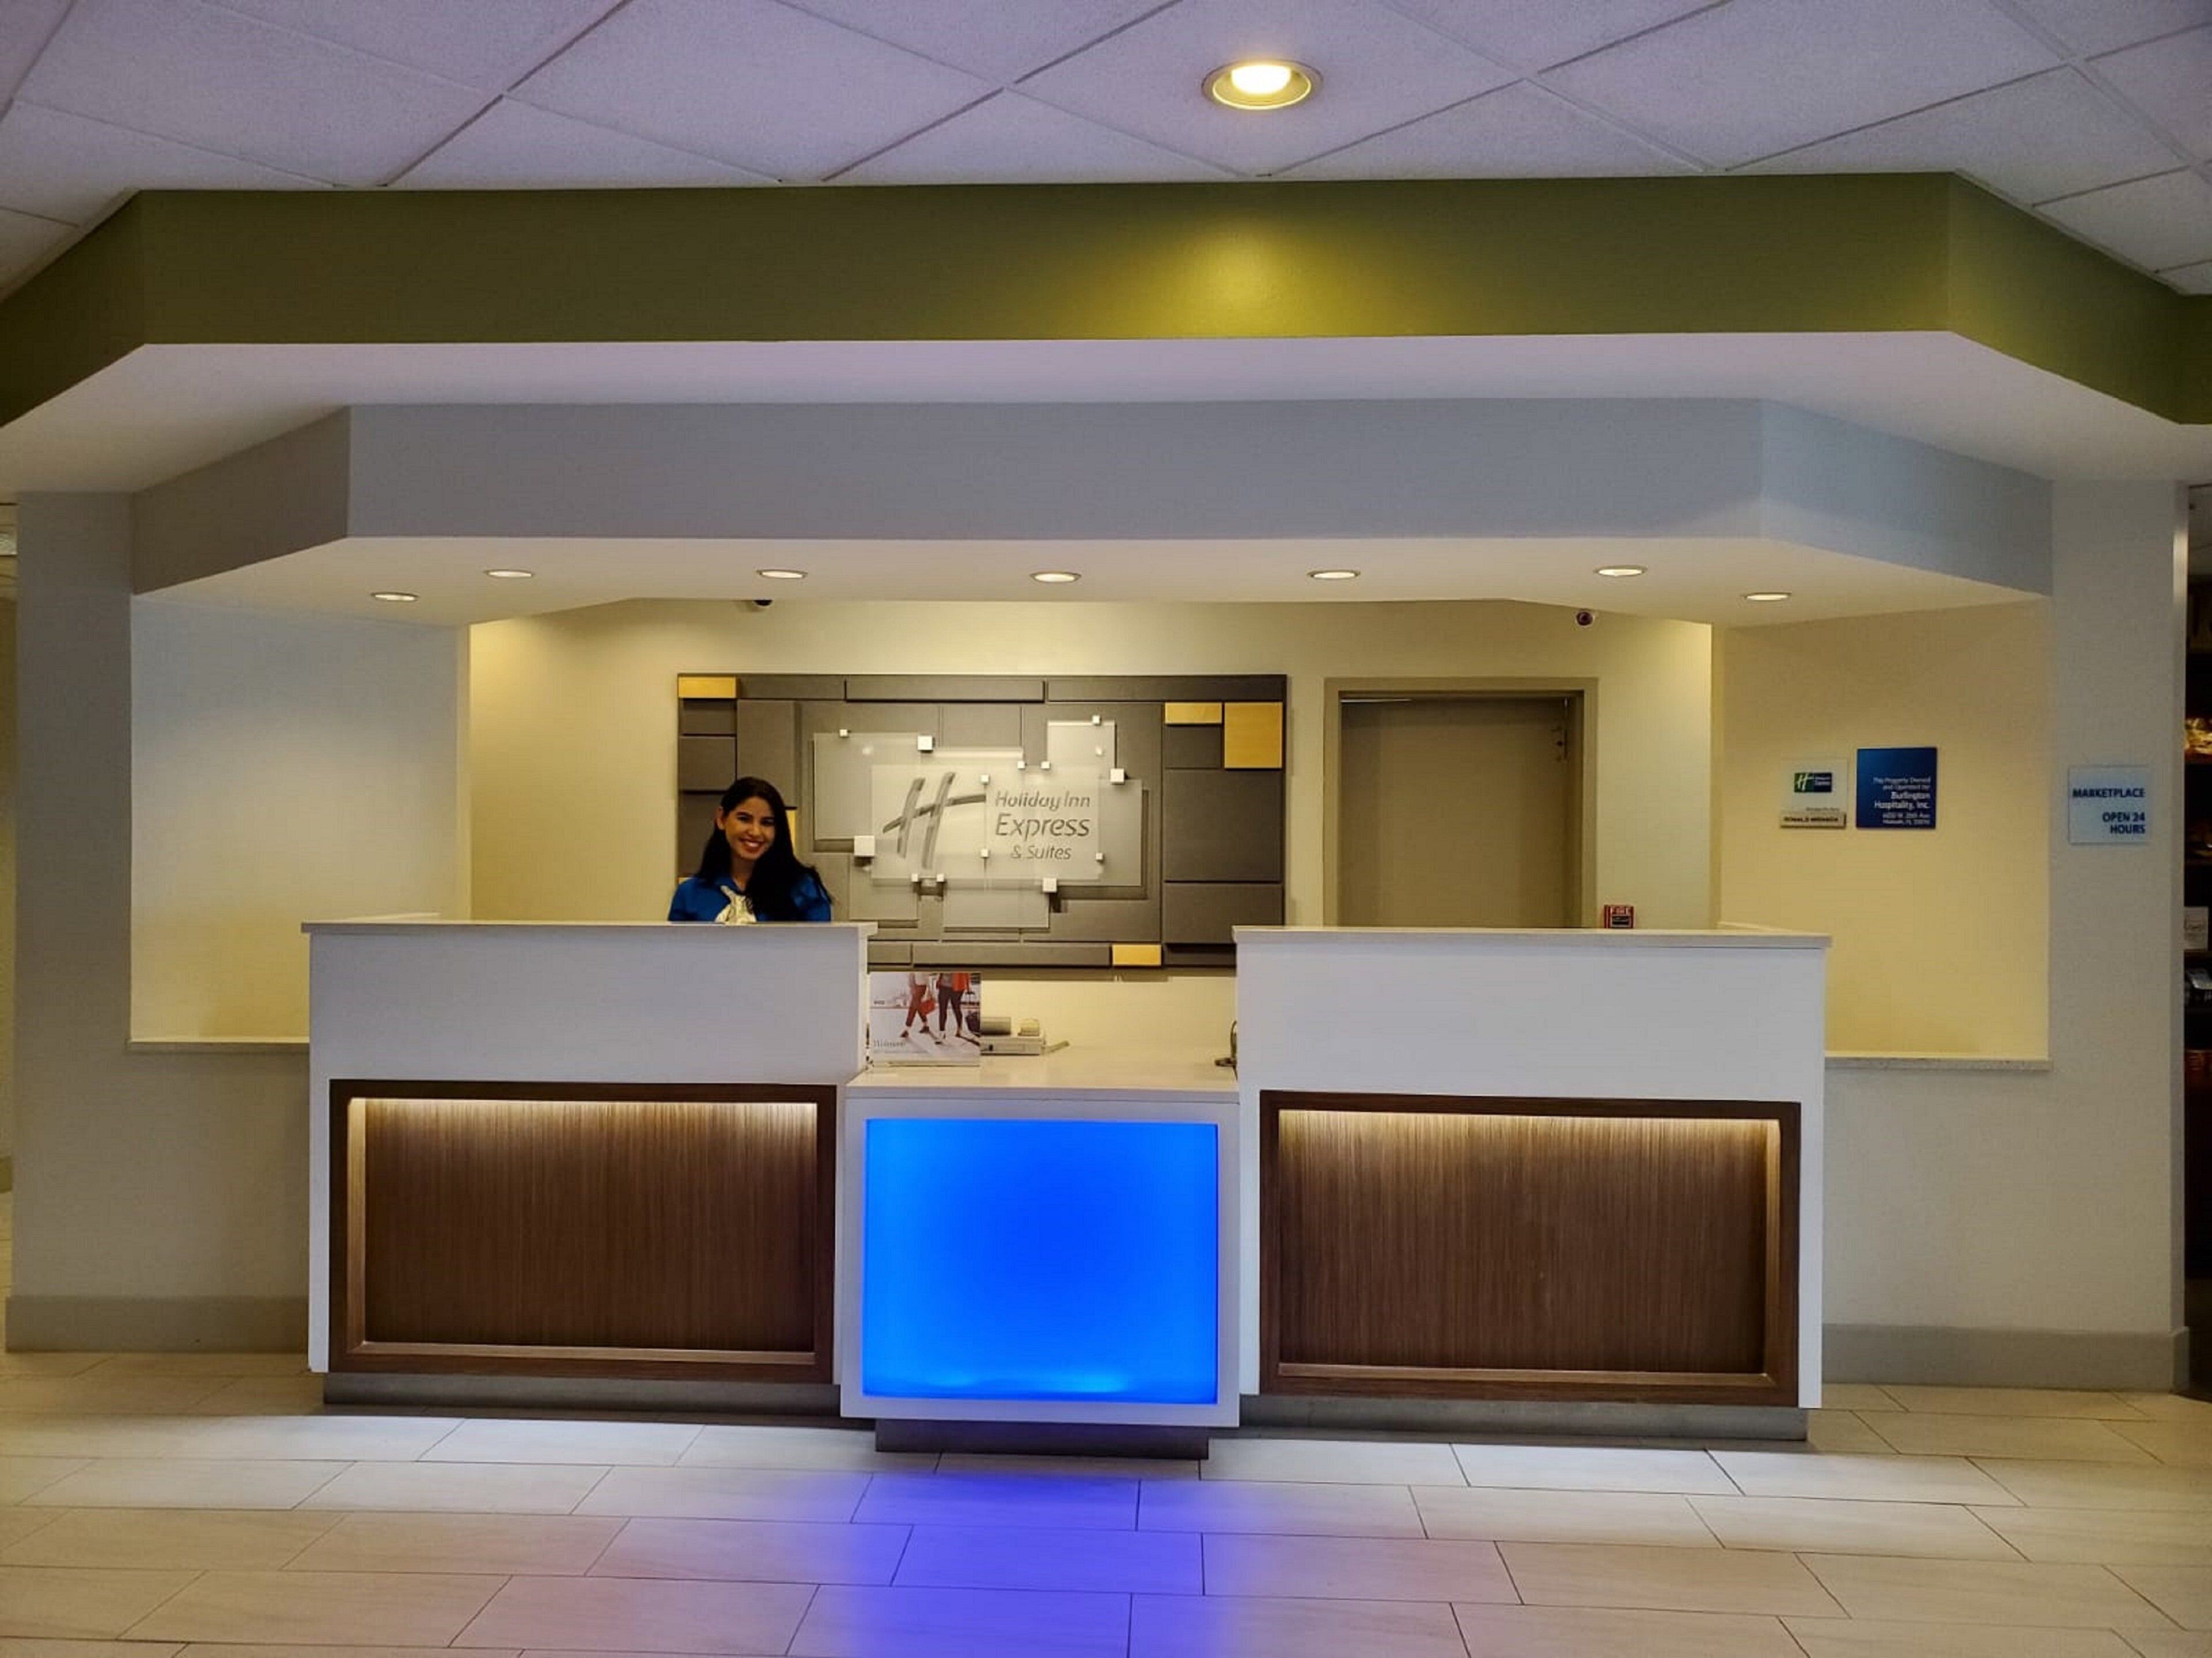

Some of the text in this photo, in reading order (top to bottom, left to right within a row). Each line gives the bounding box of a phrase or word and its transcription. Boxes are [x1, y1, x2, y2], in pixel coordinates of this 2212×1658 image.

[1891, 791, 1931, 800] Burlington
[2072, 788, 2146, 798] MARKETPLACE
[995, 790, 1091, 812] Holiday Inn
[1874, 800, 1931, 810] Hospitality, Inc.
[2102, 811, 2146, 822] OPEN 24
[995, 812, 1091, 841] Express
[2110, 824, 2146, 834] HOURS
[1010, 844, 1071, 860] & Suites
